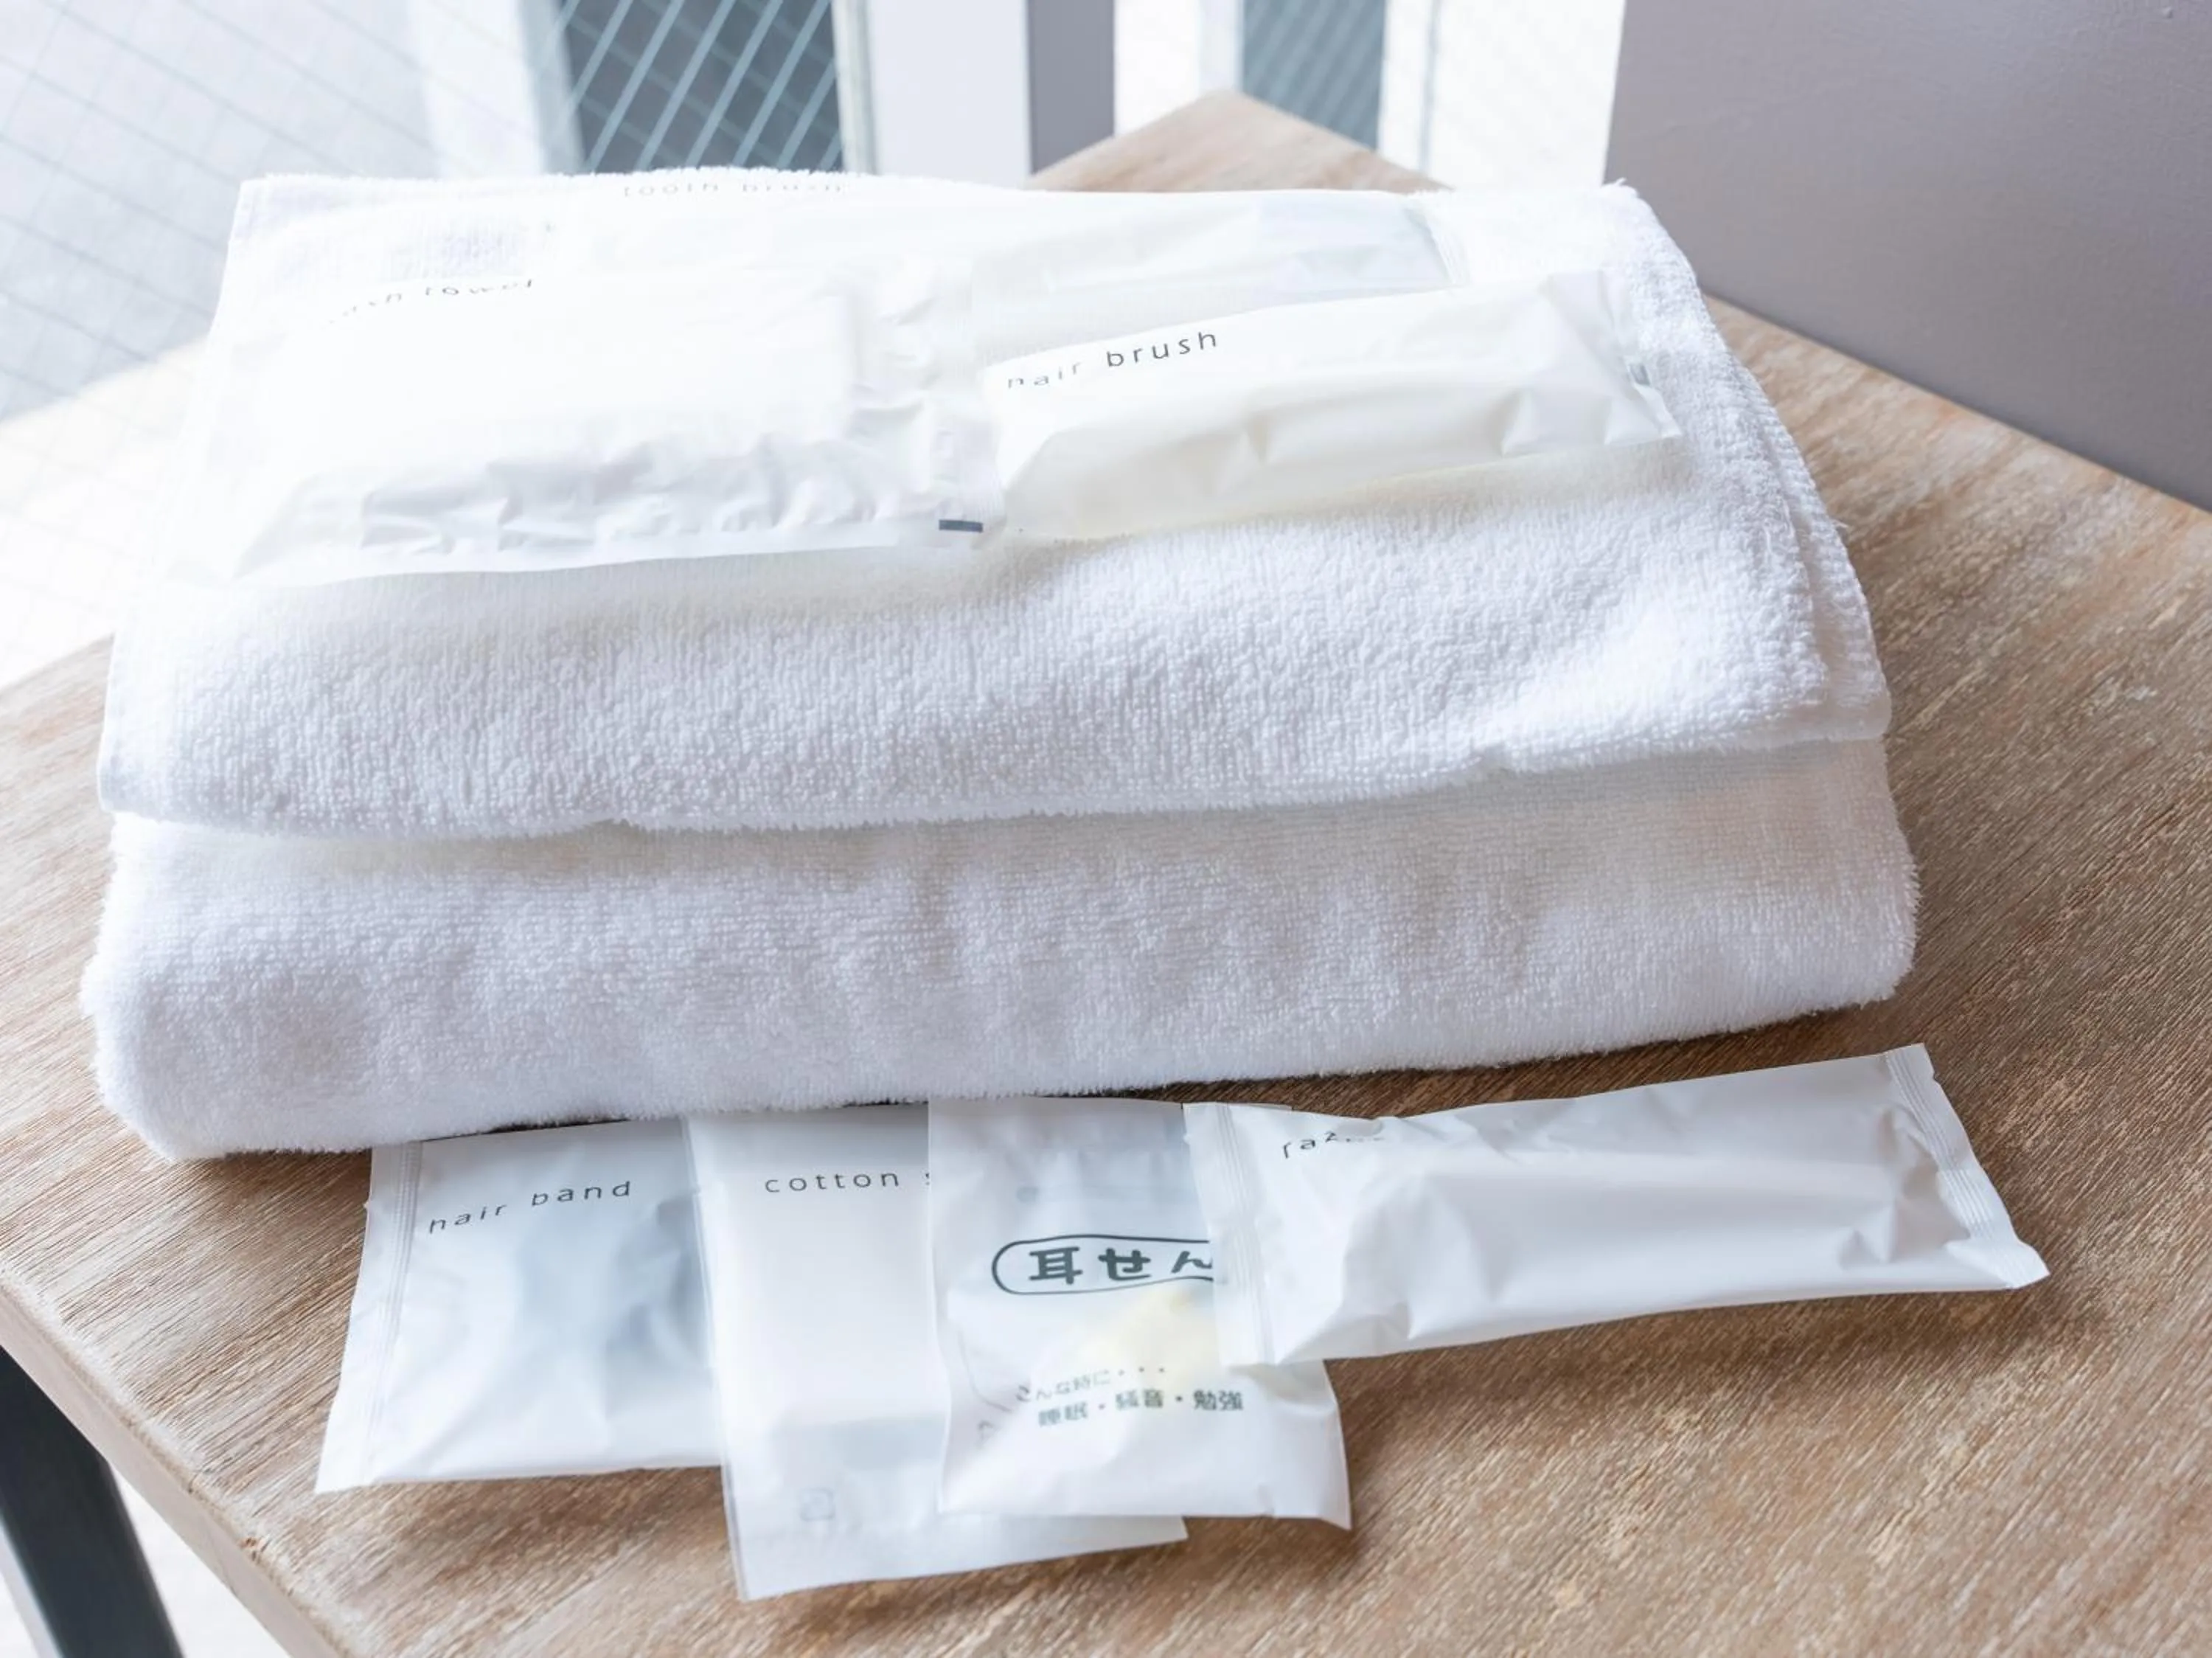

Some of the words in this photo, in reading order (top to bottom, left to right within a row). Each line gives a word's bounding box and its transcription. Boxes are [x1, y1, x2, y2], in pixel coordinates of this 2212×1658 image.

[1106, 331, 1217, 367] brush
[765, 1172, 900, 1193] cotton
[429, 1204, 507, 1234] hair
[531, 1180, 631, 1207] band
[1029, 1246, 1213, 1285] 耳せん
